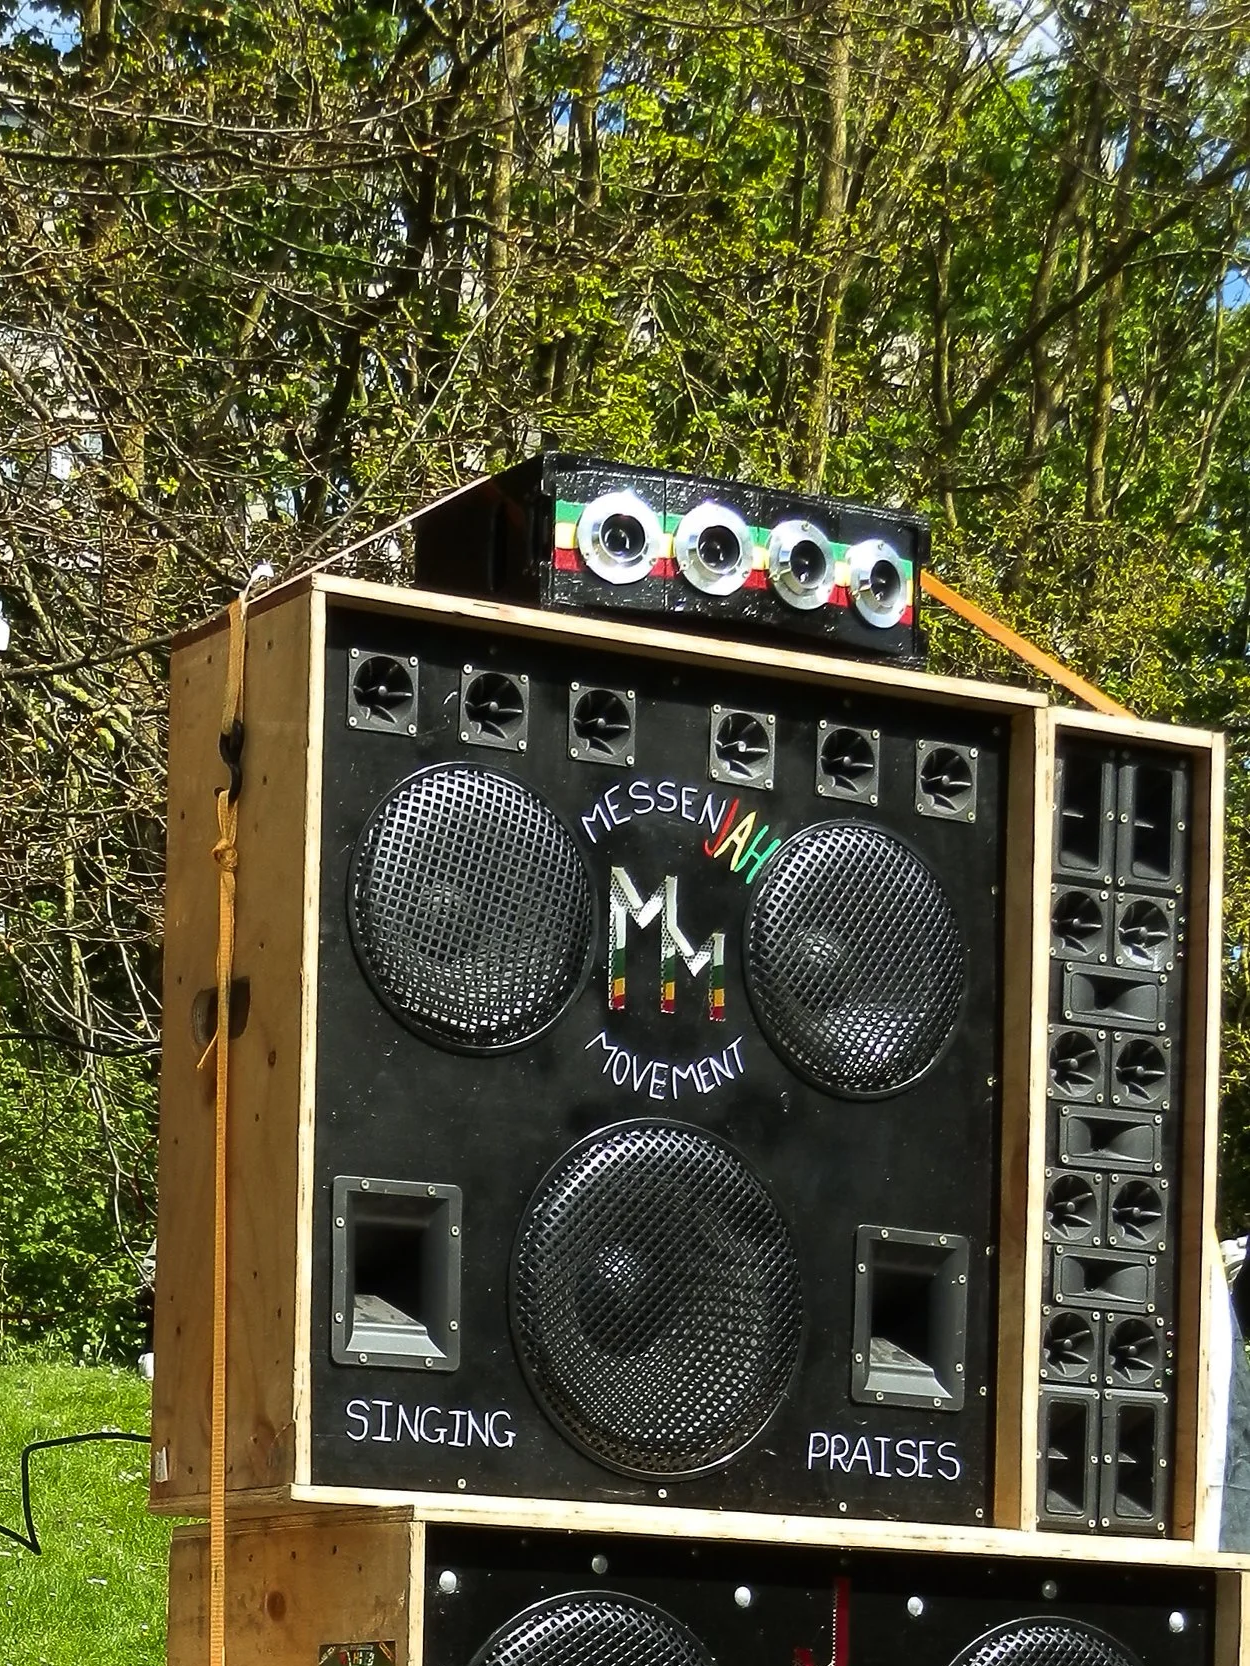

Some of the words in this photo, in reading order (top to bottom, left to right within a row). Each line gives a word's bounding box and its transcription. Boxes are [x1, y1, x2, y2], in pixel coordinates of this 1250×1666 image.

[580, 780, 781, 884] MESSENJAH
[584, 1030, 745, 1100] MOVEMENT
[345, 1399, 517, 1449] SINGING
[807, 1431, 962, 1481] PRAISES
